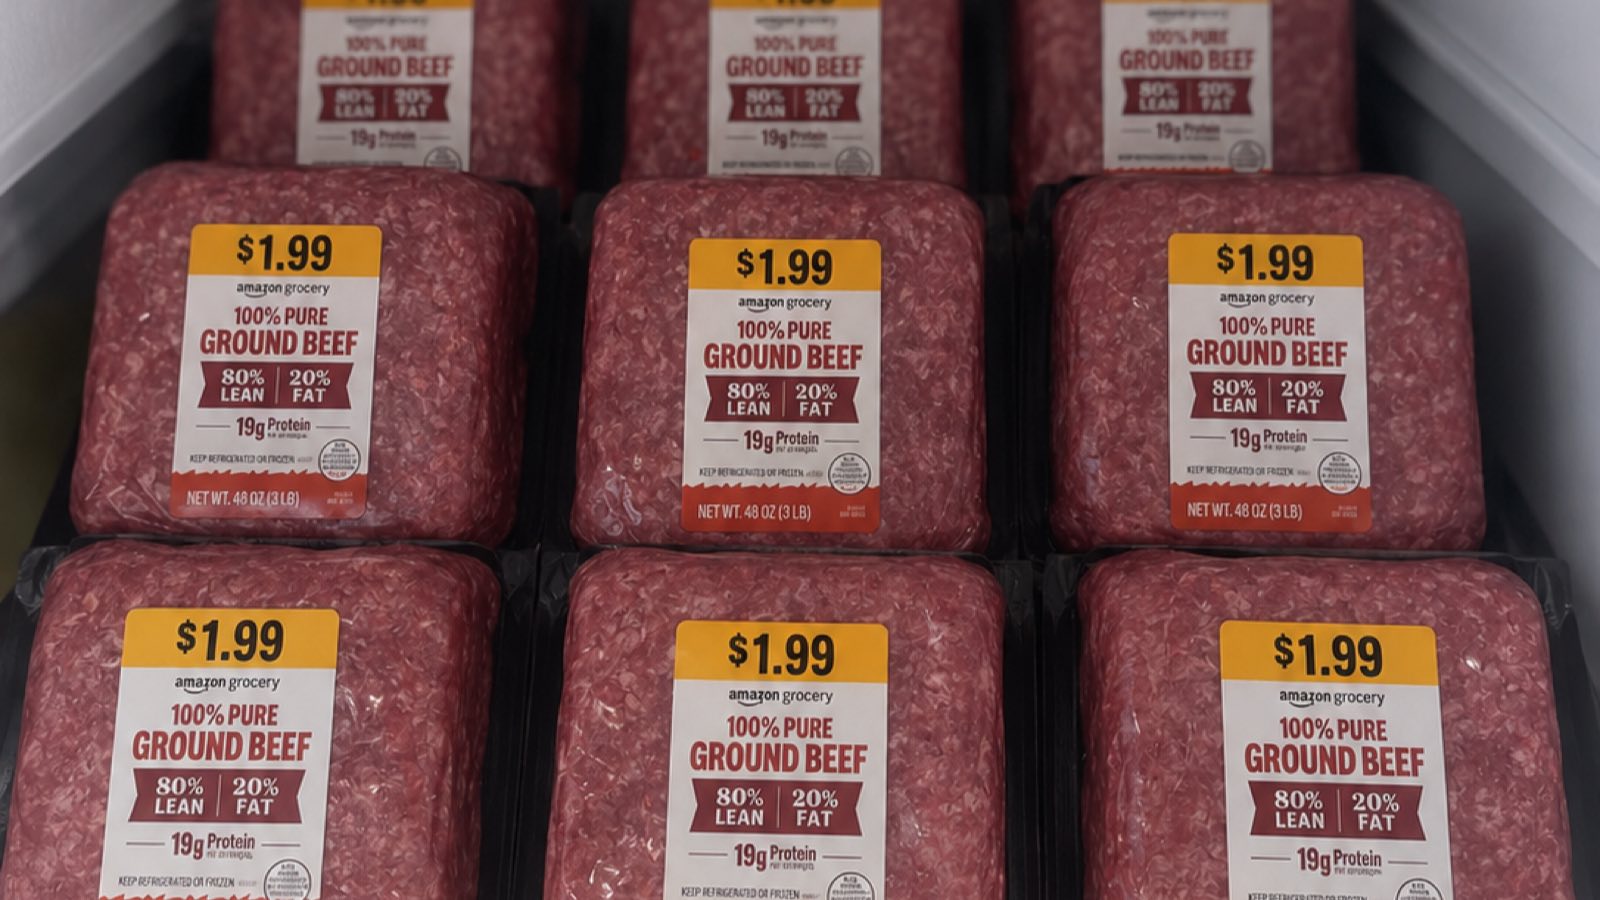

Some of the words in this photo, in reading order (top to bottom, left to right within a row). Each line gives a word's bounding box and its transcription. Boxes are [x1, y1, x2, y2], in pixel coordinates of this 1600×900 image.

[318, 55, 401, 77] GROUND
[407, 56, 454, 77] BEEF
[726, 55, 810, 77] GROUND
[816, 56, 864, 77] BEEF
[1119, 49, 1202, 70] GROUND
[1208, 50, 1254, 71] BEEF
[236, 234, 333, 271] $1.99
[1217, 243, 1314, 281] $1.99
[737, 248, 832, 286] $1.99
[237, 283, 282, 297] amazon
[284, 284, 330, 296] grocery
[738, 298, 784, 312] amazon
[787, 298, 832, 311] grocery
[1220, 293, 1266, 307] amazon
[1269, 294, 1314, 306] grocery
[234, 306, 281, 325] 100%
[285, 307, 329, 325] PURE
[737, 320, 784, 339] 100%
[788, 321, 832, 340] PURE
[1219, 316, 1267, 335] 100%
[1271, 317, 1315, 336] PURE
[200, 329, 298, 356] GROUND
[303, 330, 359, 356] BEEF
[703, 343, 802, 369] GROUND
[807, 345, 863, 370] BEEF
[1187, 339, 1286, 366] GROUND
[1292, 341, 1348, 367] BEEF
[221, 368, 265, 386] 80%
[289, 369, 331, 386] 20%
[220, 387, 265, 402] LEAN
[292, 388, 326, 403] FAT
[727, 382, 770, 399] 80%
[796, 383, 837, 400] 20%
[1212, 379, 1256, 396] 80%
[1281, 380, 1324, 397] 20%
[727, 401, 770, 416] LEAN
[799, 402, 833, 416] FAT
[1213, 397, 1258, 413] LEAN
[1286, 399, 1320, 414] FAT
[236, 416, 265, 441] 19g
[267, 417, 311, 431] Protein
[743, 430, 774, 454] 19g
[776, 431, 819, 445] Protein
[1230, 427, 1261, 453] 19g
[1264, 429, 1308, 443] Protein
[187, 490, 209, 505] NET
[211, 490, 231, 505] WT.
[250, 490, 265, 505] OZ
[267, 490, 279, 507] (3
[280, 490, 299, 508] LB)
[698, 504, 720, 519] NET
[721, 504, 742, 519] WT.
[744, 504, 759, 519] 48
[761, 504, 776, 519] OZ
[778, 504, 790, 521] (3
[792, 504, 811, 521] LB)
[1187, 502, 1210, 517] NET
[1211, 503, 1233, 517] WT.
[1235, 503, 1249, 518] 48
[1251, 503, 1267, 518] OZ
[1269, 503, 1281, 520] (3
[1283, 504, 1302, 521] LB)
[176, 619, 284, 662] $1.99
[728, 633, 835, 676] $1.99
[1274, 633, 1383, 677] $1.99
[175, 677, 226, 693] amazon
[229, 678, 280, 692] grocery
[729, 690, 780, 706] amazon
[783, 691, 834, 705] grocery
[1280, 691, 1331, 708] amazon
[1334, 692, 1385, 707] grocery
[171, 704, 224, 725] 100%
[228, 704, 279, 726] PURE
[727, 716, 780, 738] 100%
[784, 717, 833, 739] PURE
[1280, 717, 1333, 739] 100%
[1338, 719, 1388, 741] PURE
[132, 731, 243, 761] GROUND
[248, 732, 312, 761] BEEF
[690, 741, 799, 772] GROUND
[805, 744, 868, 774] BEEF
[1245, 743, 1356, 775] GROUND
[1362, 746, 1424, 777] BEEF
[156, 777, 204, 796] 80%
[232, 777, 279, 796] 20%
[155, 798, 204, 814] LEAN
[716, 787, 764, 807] 80%
[792, 789, 839, 808] 20%
[1274, 790, 1323, 809] 80%
[1352, 793, 1399, 812] 20%
[236, 799, 274, 815] FAT
[715, 809, 764, 826] LEAN
[796, 810, 833, 827] FAT
[1275, 811, 1324, 829] LEAN
[1358, 814, 1395, 831] FAT
[171, 832, 204, 860] 19g
[207, 832, 255, 849] Protein
[734, 843, 767, 872] 19g
[770, 844, 817, 862] Protein
[1297, 848, 1330, 876] 19g
[1334, 849, 1382, 867] Protein
[118, 876, 137, 887] KEEP
